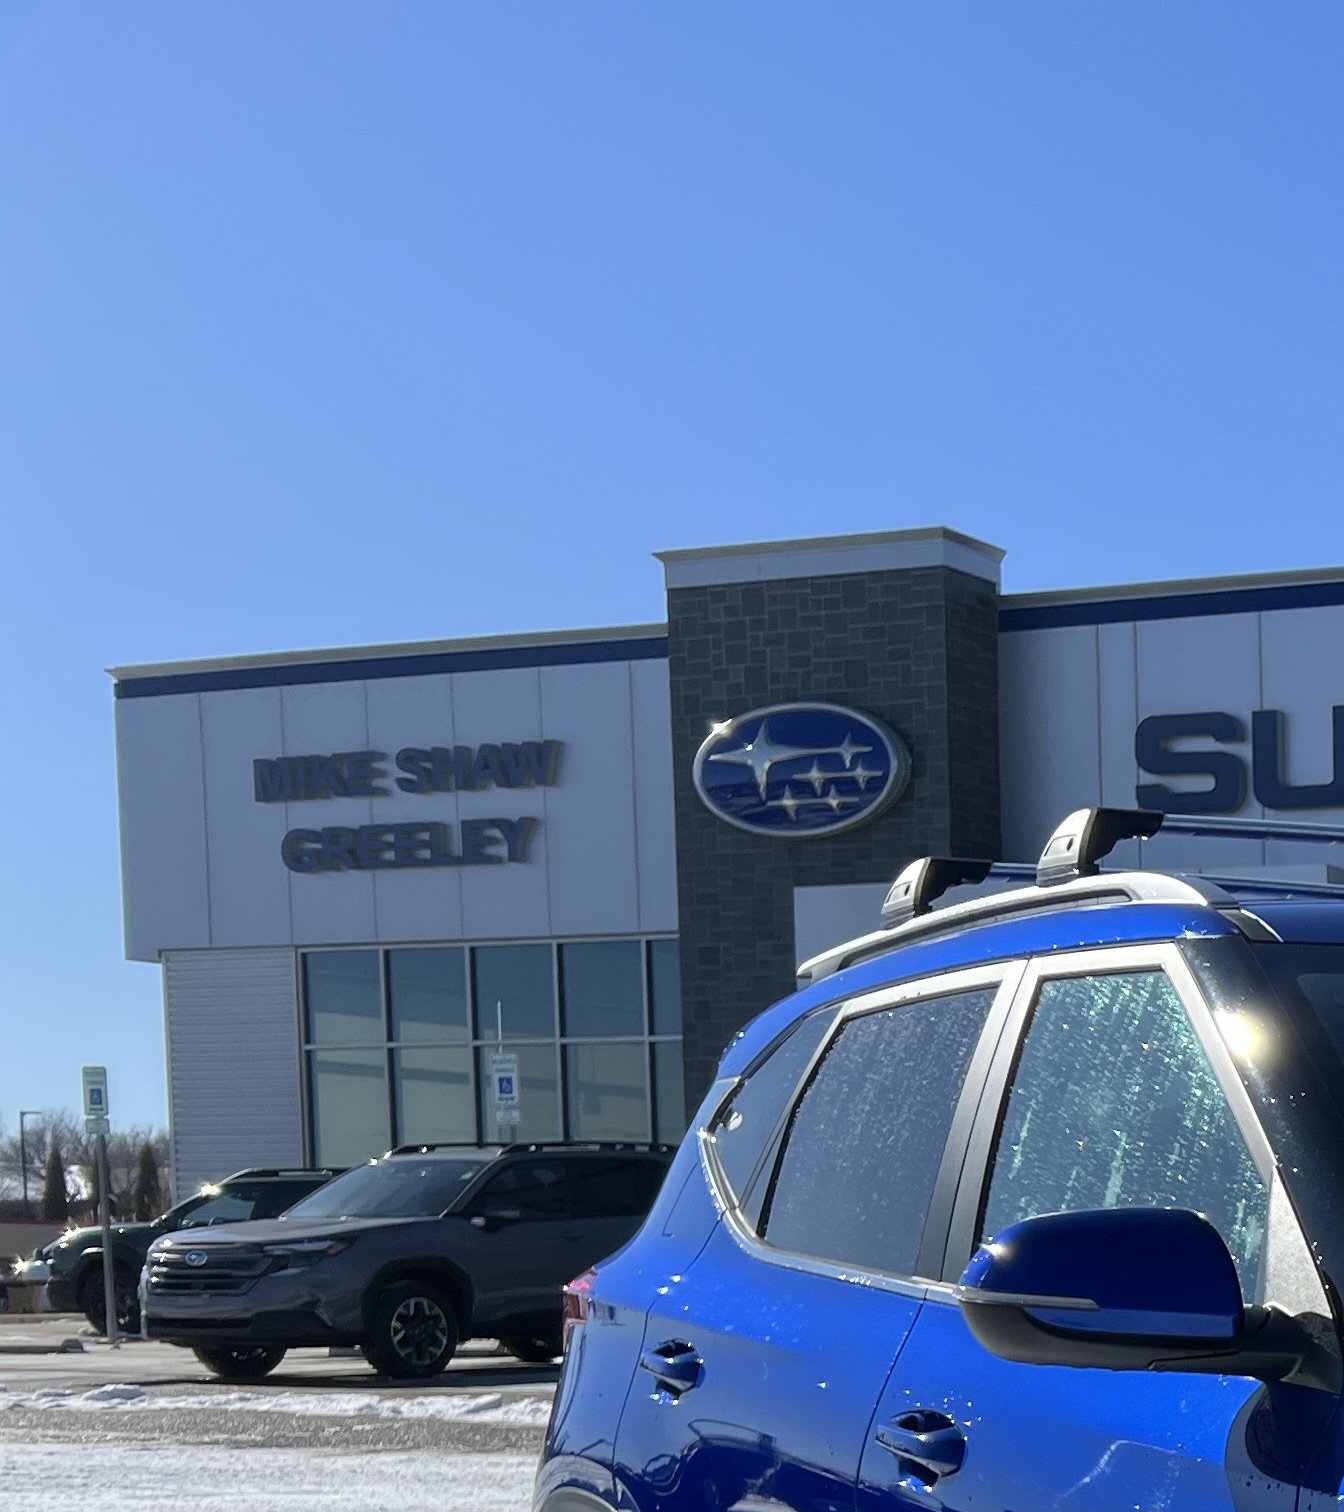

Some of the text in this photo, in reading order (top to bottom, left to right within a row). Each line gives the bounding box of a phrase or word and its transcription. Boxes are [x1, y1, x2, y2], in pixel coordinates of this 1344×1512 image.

[253, 739, 565, 802] MIKE SHAW
[281, 816, 541, 873] GREELEY
